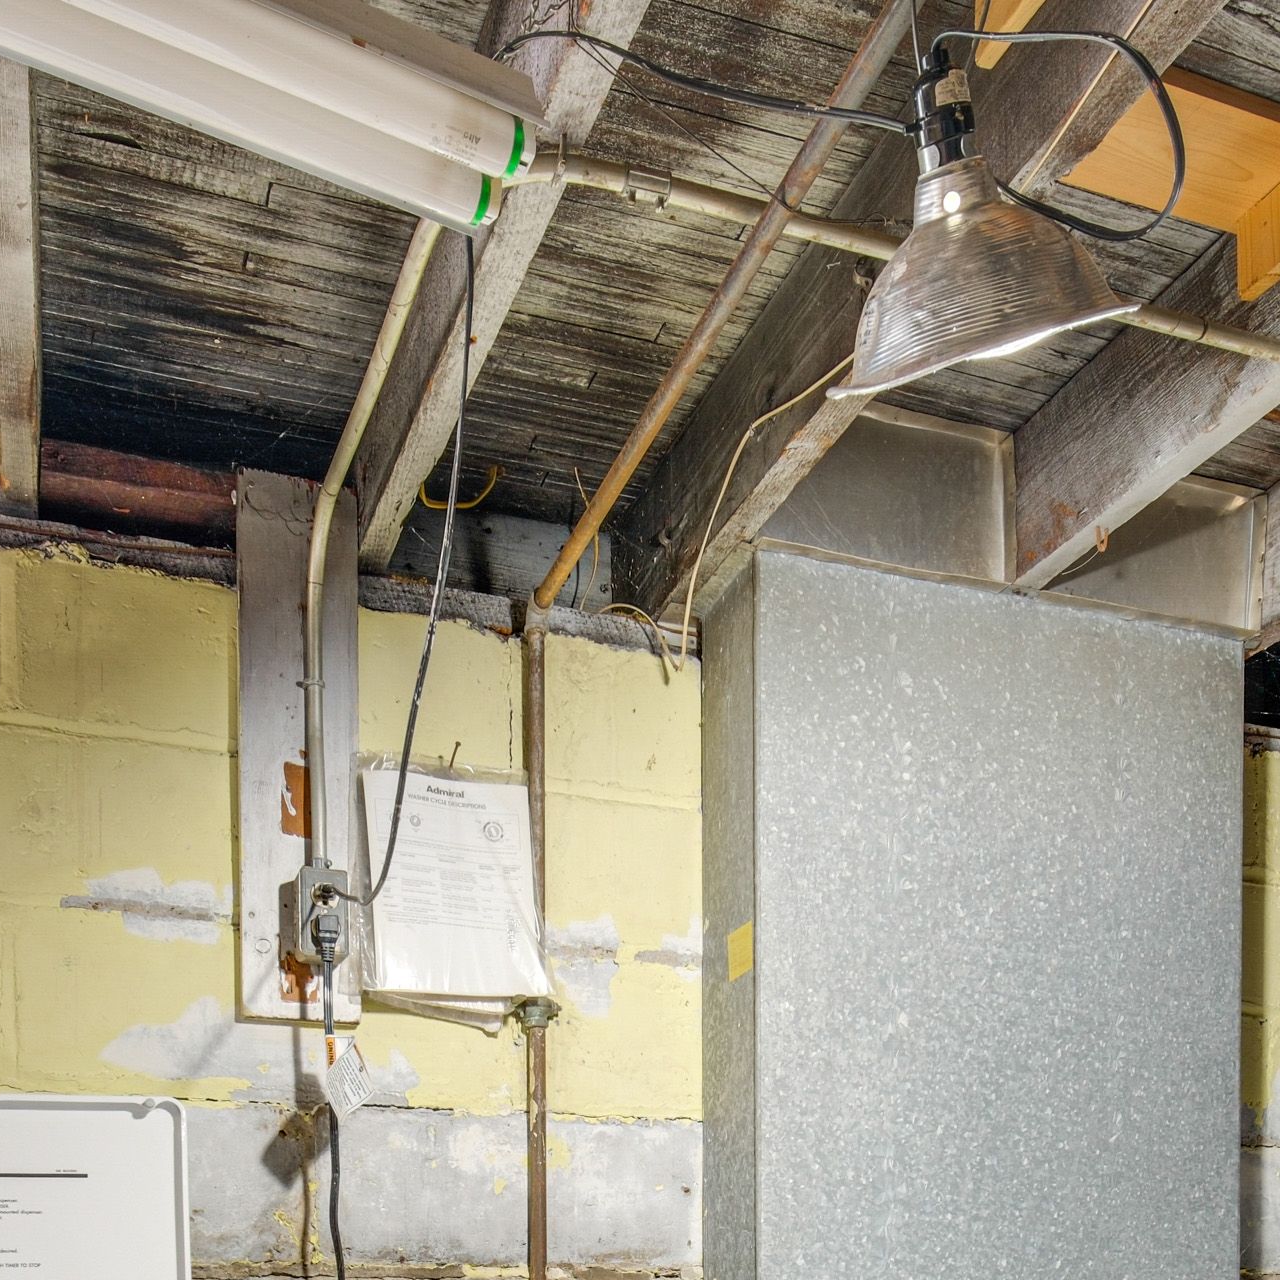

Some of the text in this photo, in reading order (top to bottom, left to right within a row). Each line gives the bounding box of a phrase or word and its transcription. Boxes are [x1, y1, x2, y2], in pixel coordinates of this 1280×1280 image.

[426, 785, 465, 798] Admiral
[408, 793, 429, 802] WASHER
[430, 797, 446, 806] CYCLE
